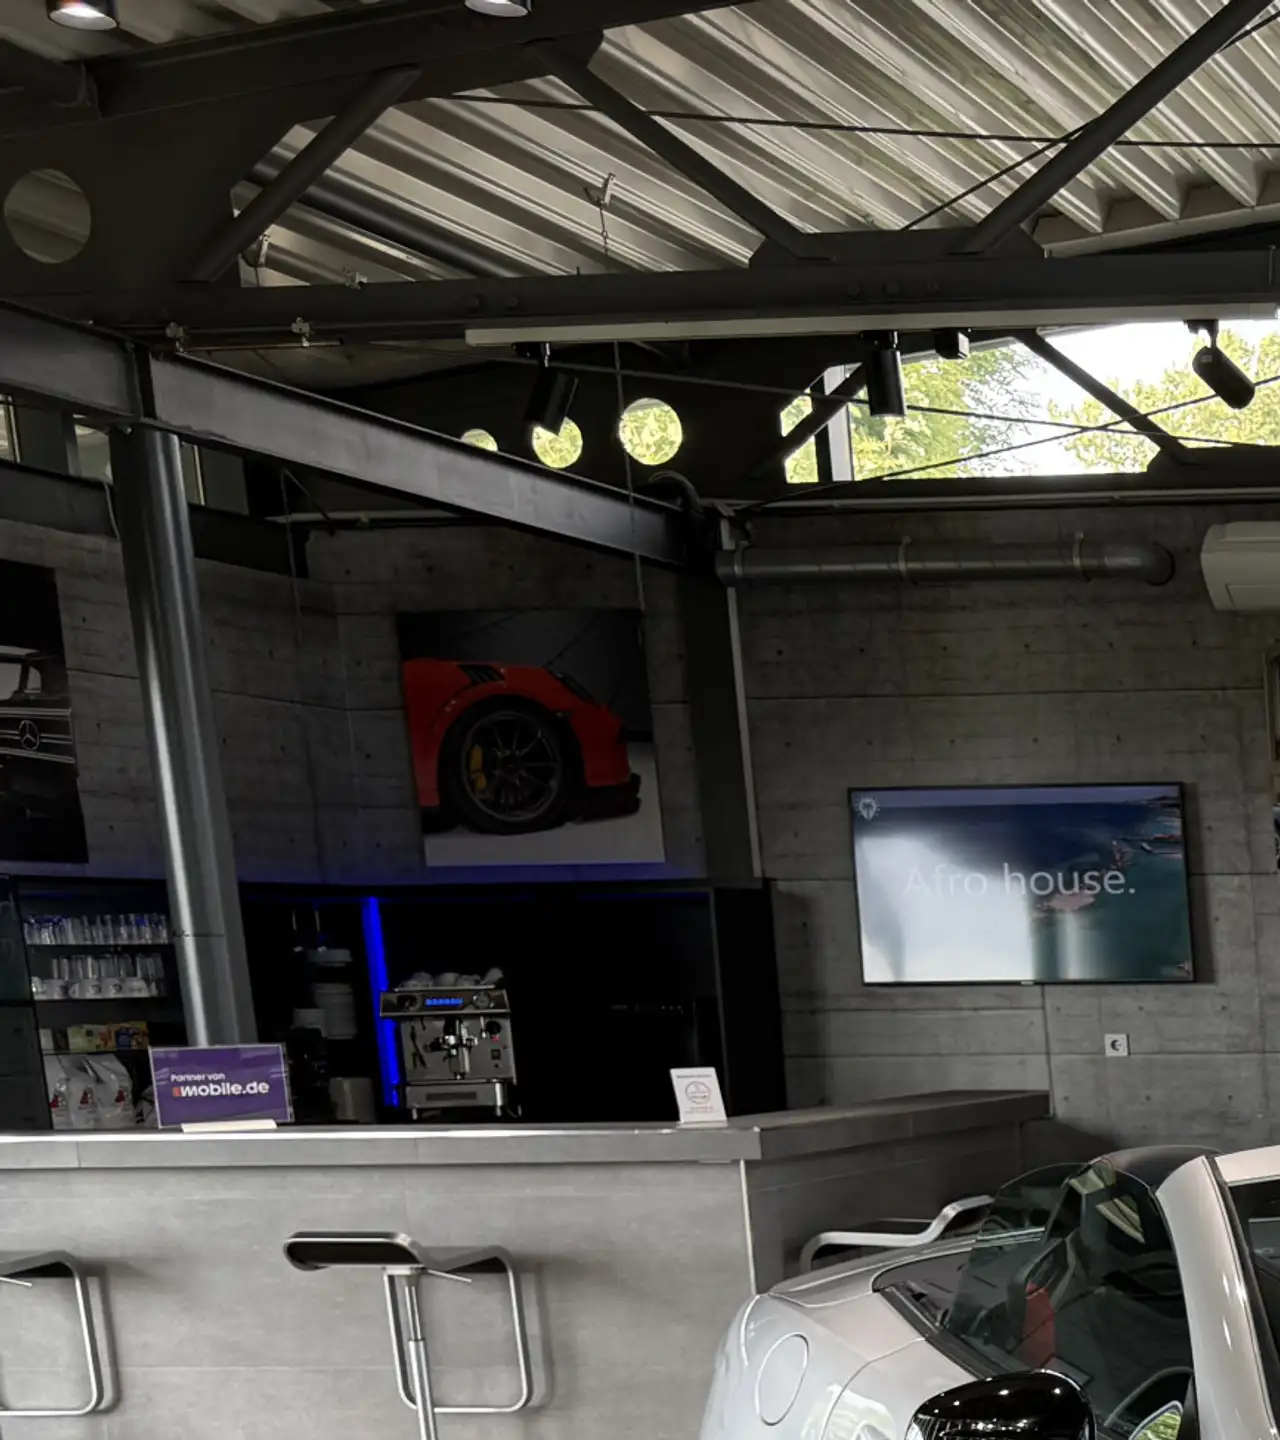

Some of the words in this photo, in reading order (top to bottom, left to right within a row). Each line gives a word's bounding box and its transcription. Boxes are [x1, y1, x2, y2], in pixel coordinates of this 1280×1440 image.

[904, 864, 988, 897] Afro
[1004, 863, 1136, 895] house.
[170, 1073, 206, 1082] Partner
[180, 1081, 270, 1097] mobile.de
